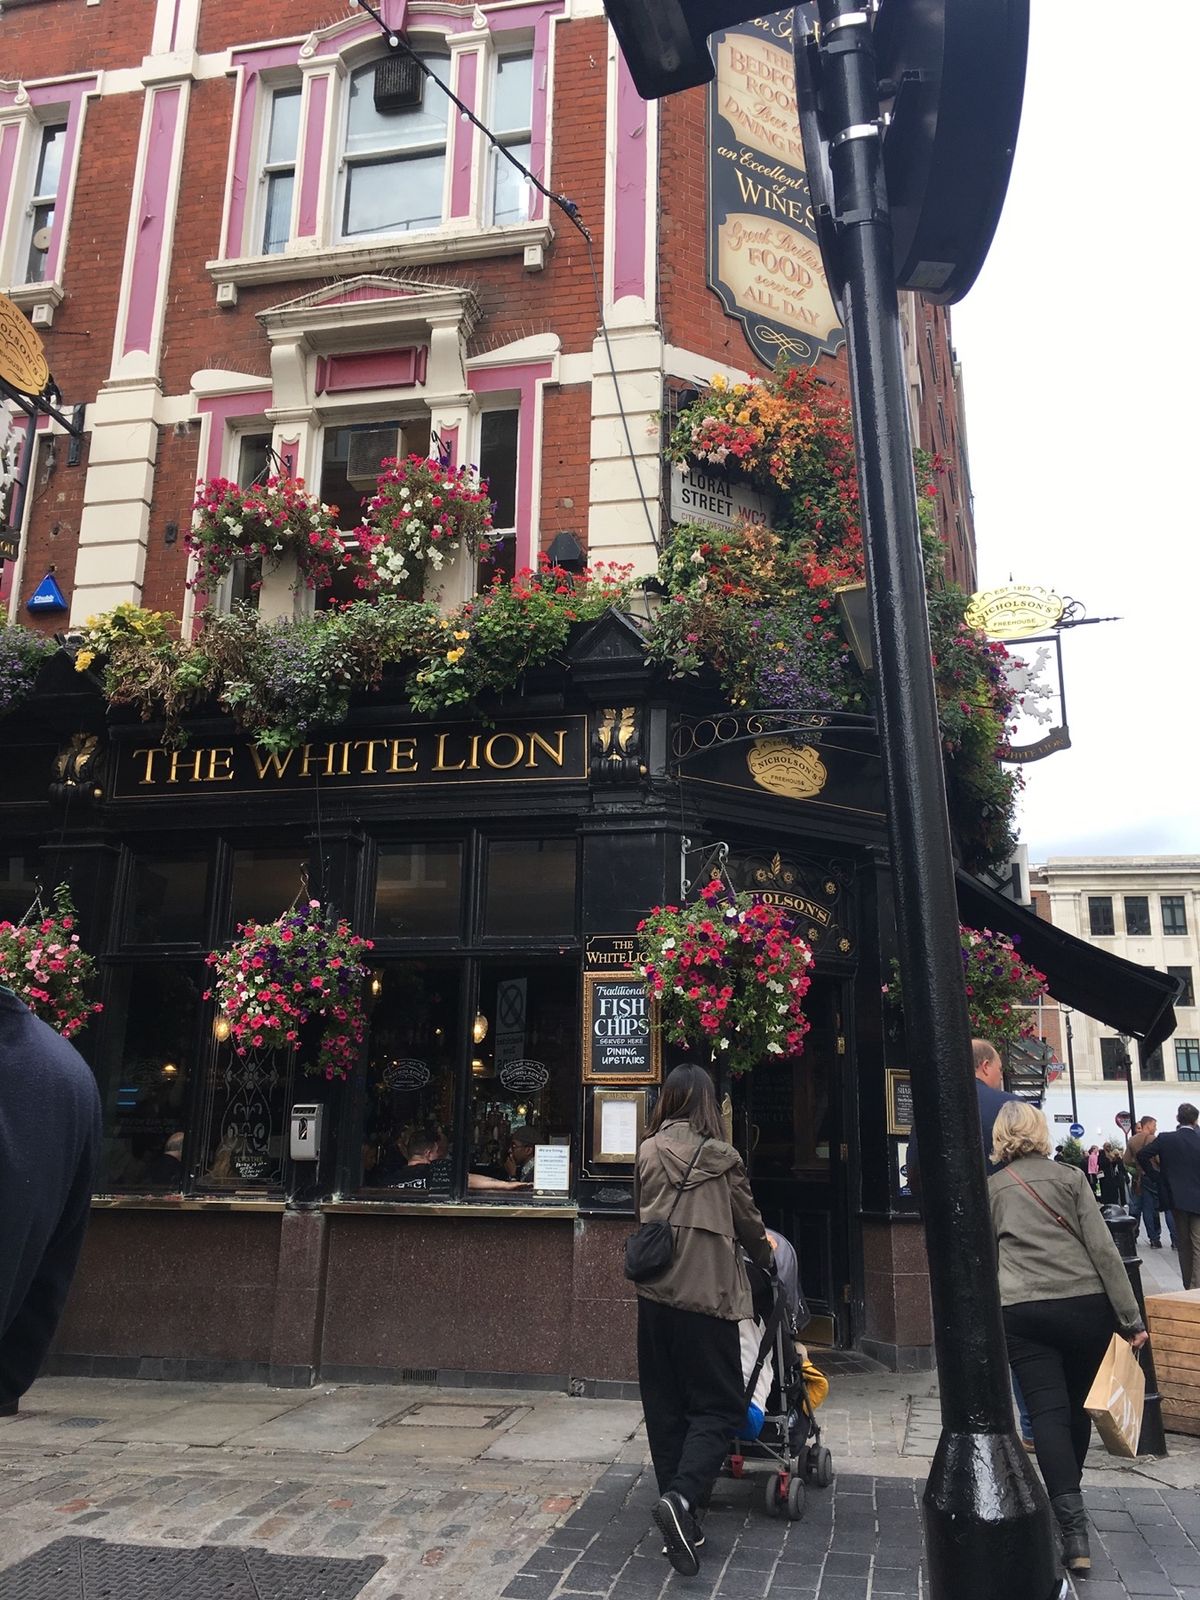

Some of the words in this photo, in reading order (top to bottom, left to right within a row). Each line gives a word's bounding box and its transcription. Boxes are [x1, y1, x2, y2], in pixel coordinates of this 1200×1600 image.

[730, 46, 795, 93] BEDFO
[725, 96, 786, 150] DINING
[717, 146, 737, 160] an
[740, 147, 803, 190] Excellent
[734, 167, 817, 234] WINES
[772, 184, 787, 195] of
[748, 247, 813, 289] FOOD
[755, 274, 807, 301] served
[742, 286, 779, 312] ALL
[782, 299, 821, 327] DAY
[1, 323, 39, 376] OLSON'S
[0, 351, 24, 375] HOUSE
[681, 470, 733, 499] FLORAL
[681, 488, 733, 517] STREET
[977, 601, 1052, 620] NICHOLSON'S
[993, 618, 1037, 627] FREEHOUSE
[132, 747, 235, 785] THE
[245, 738, 419, 780] WHITE
[431, 730, 568, 771] LION
[757, 756, 818, 780] NICHOLSON'S
[770, 775, 805, 786] FREEHOUSE
[752, 893, 827, 922] OLSON'S
[586, 951, 627, 964] WHITE
[628, 950, 650, 963] LIO
[612, 940, 635, 950] THE
[596, 985, 646, 997] Traditiona
[599, 998, 646, 1016] FISH
[594, 1018, 650, 1036] CHIPS
[601, 1056, 646, 1065] UPSTAIRS
[606, 1047, 638, 1056] DINING
